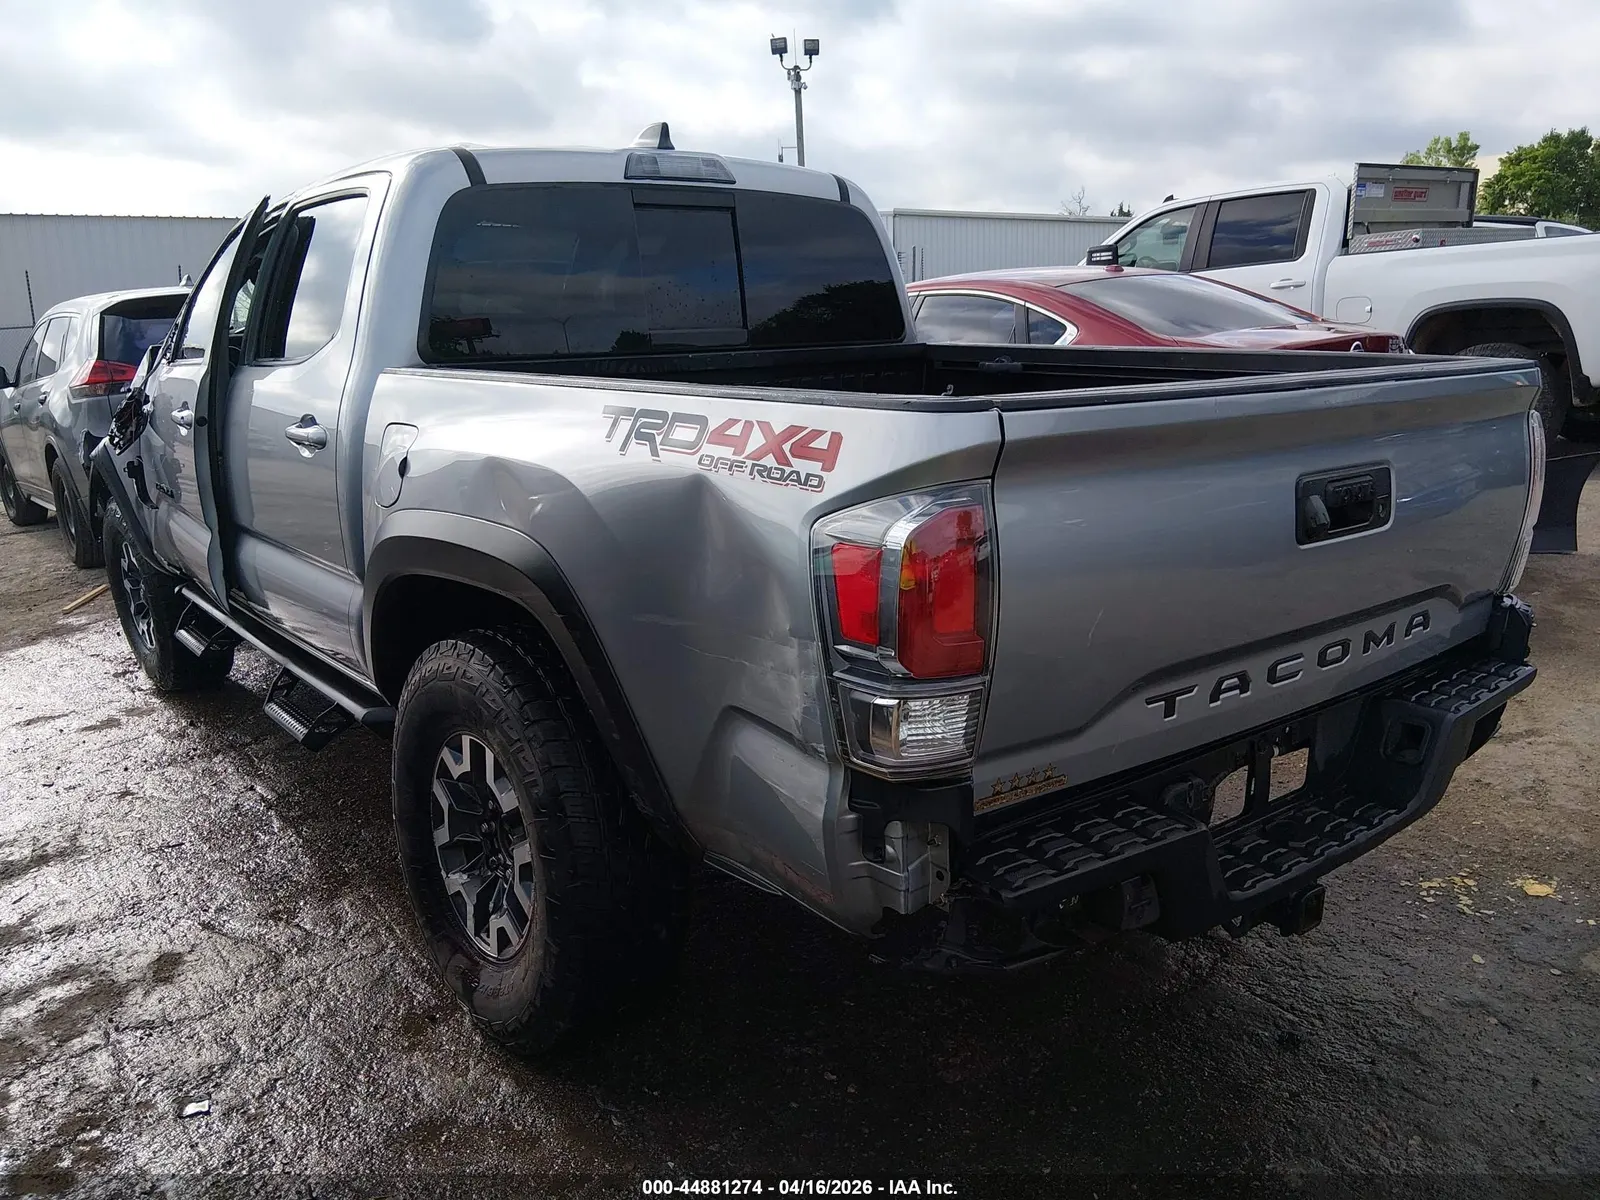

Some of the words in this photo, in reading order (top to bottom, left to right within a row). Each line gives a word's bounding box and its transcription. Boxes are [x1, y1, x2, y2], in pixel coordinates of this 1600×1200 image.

[602, 405, 709, 462] TRD
[706, 417, 844, 473] 4X4
[697, 453, 747, 476] OFF
[749, 462, 826, 493] ROAD
[1144, 609, 1431, 722] TACOMA
